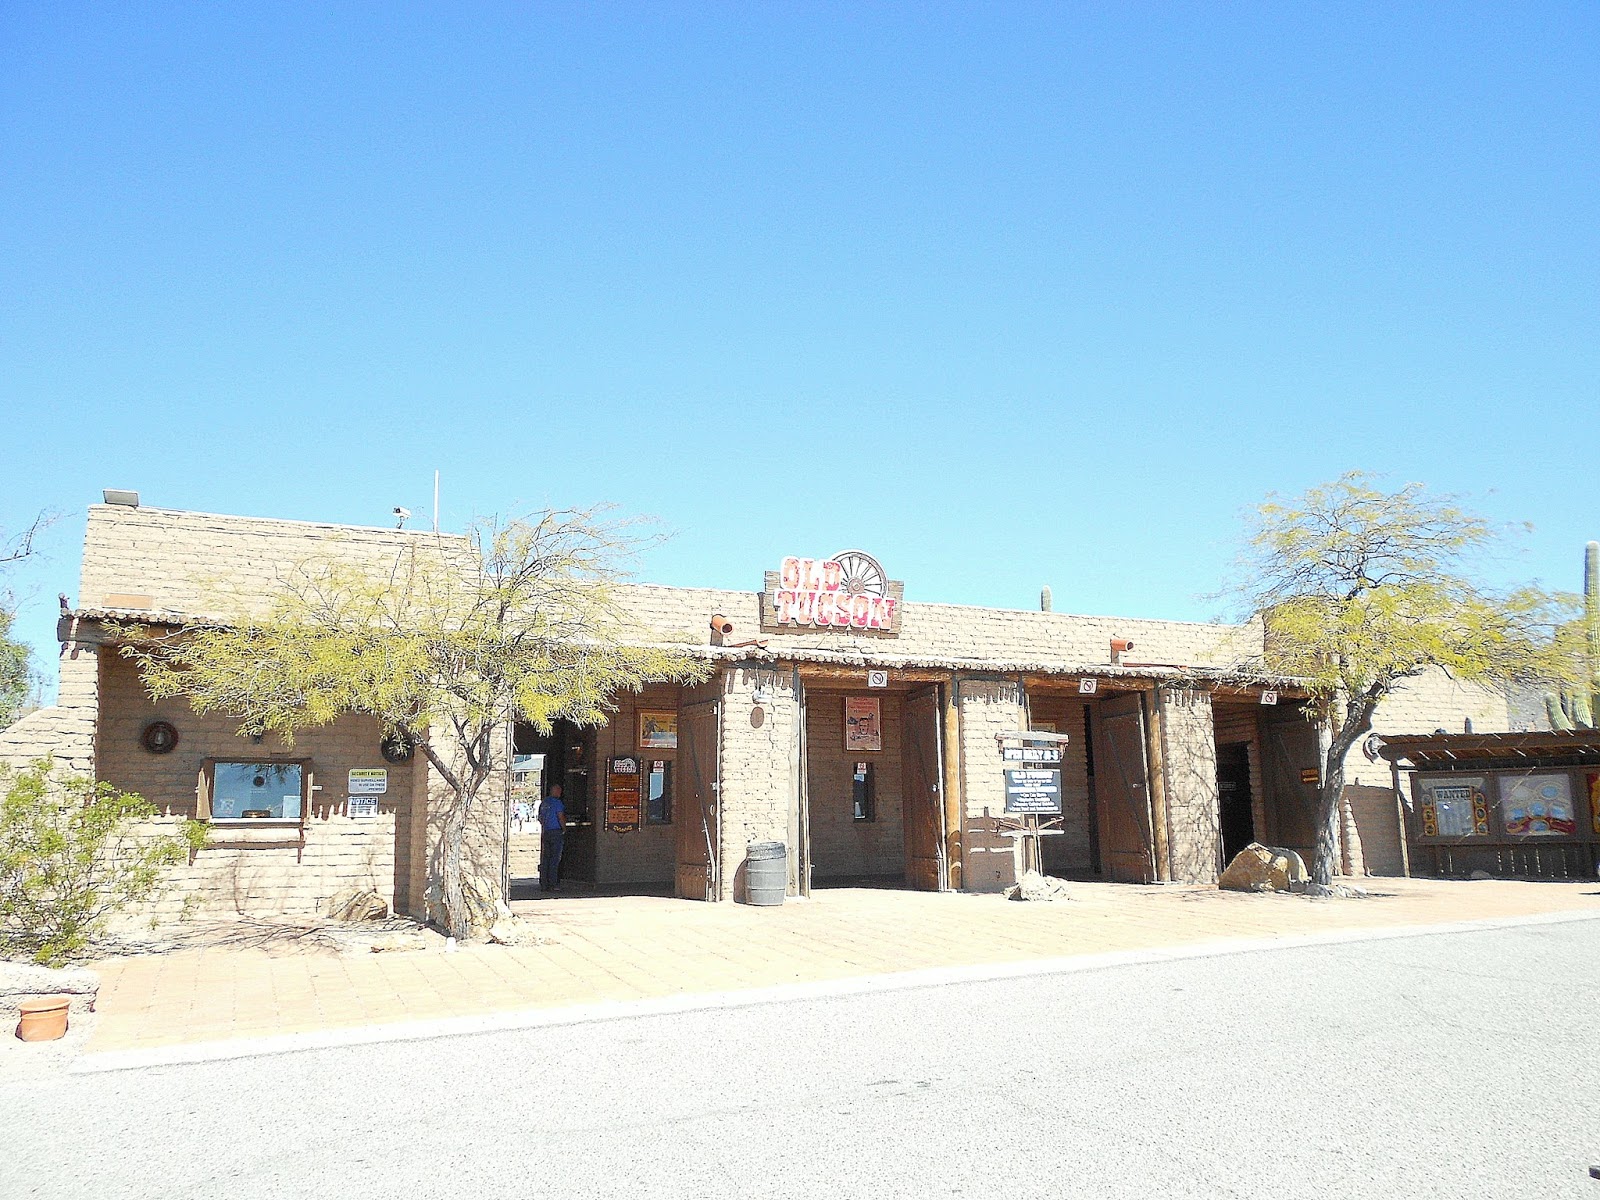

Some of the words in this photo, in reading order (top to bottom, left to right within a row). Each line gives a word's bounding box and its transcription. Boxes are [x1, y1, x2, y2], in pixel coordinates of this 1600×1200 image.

[781, 557, 842, 591] OLD
[775, 590, 896, 630] TUCSON
[1436, 790, 1470, 799] WANTED
